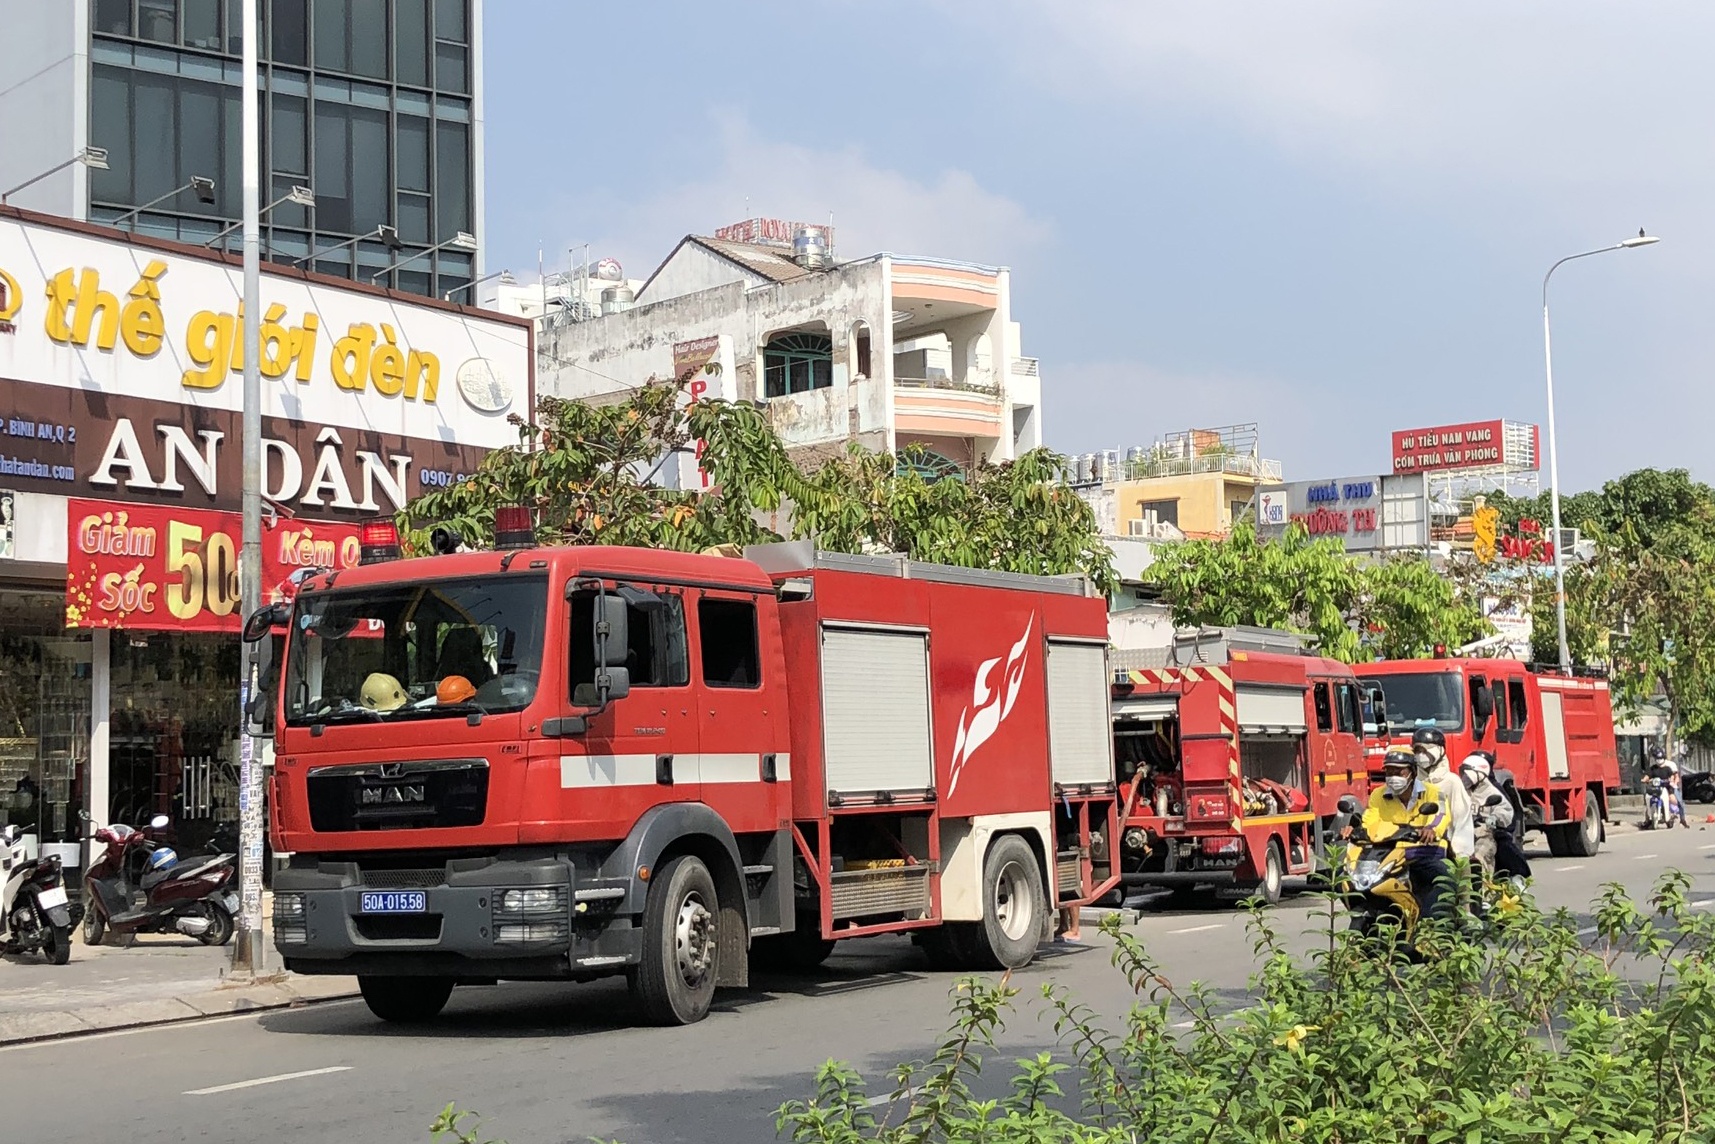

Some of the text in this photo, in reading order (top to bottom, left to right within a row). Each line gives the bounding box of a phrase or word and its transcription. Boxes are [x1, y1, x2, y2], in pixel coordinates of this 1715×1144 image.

[45, 260, 441, 402] thế giới đèn
[675, 344, 690, 355] Hair
[9, 416, 35, 437] BÌNH
[67, 426, 76, 442] 2
[1442, 432, 1463, 445] NAM
[1465, 428, 1492, 442] VANG
[88, 418, 413, 513] AN DÂN
[420, 469, 454, 487] 0907
[80, 510, 157, 557] Giảm
[280, 527, 335, 568] Kèm
[99, 563, 157, 613] Sốc
[362, 785, 425, 804] MAN
[1203, 858, 1238, 867] MAN
[364, 893, 423, 910] 50A-015.58
